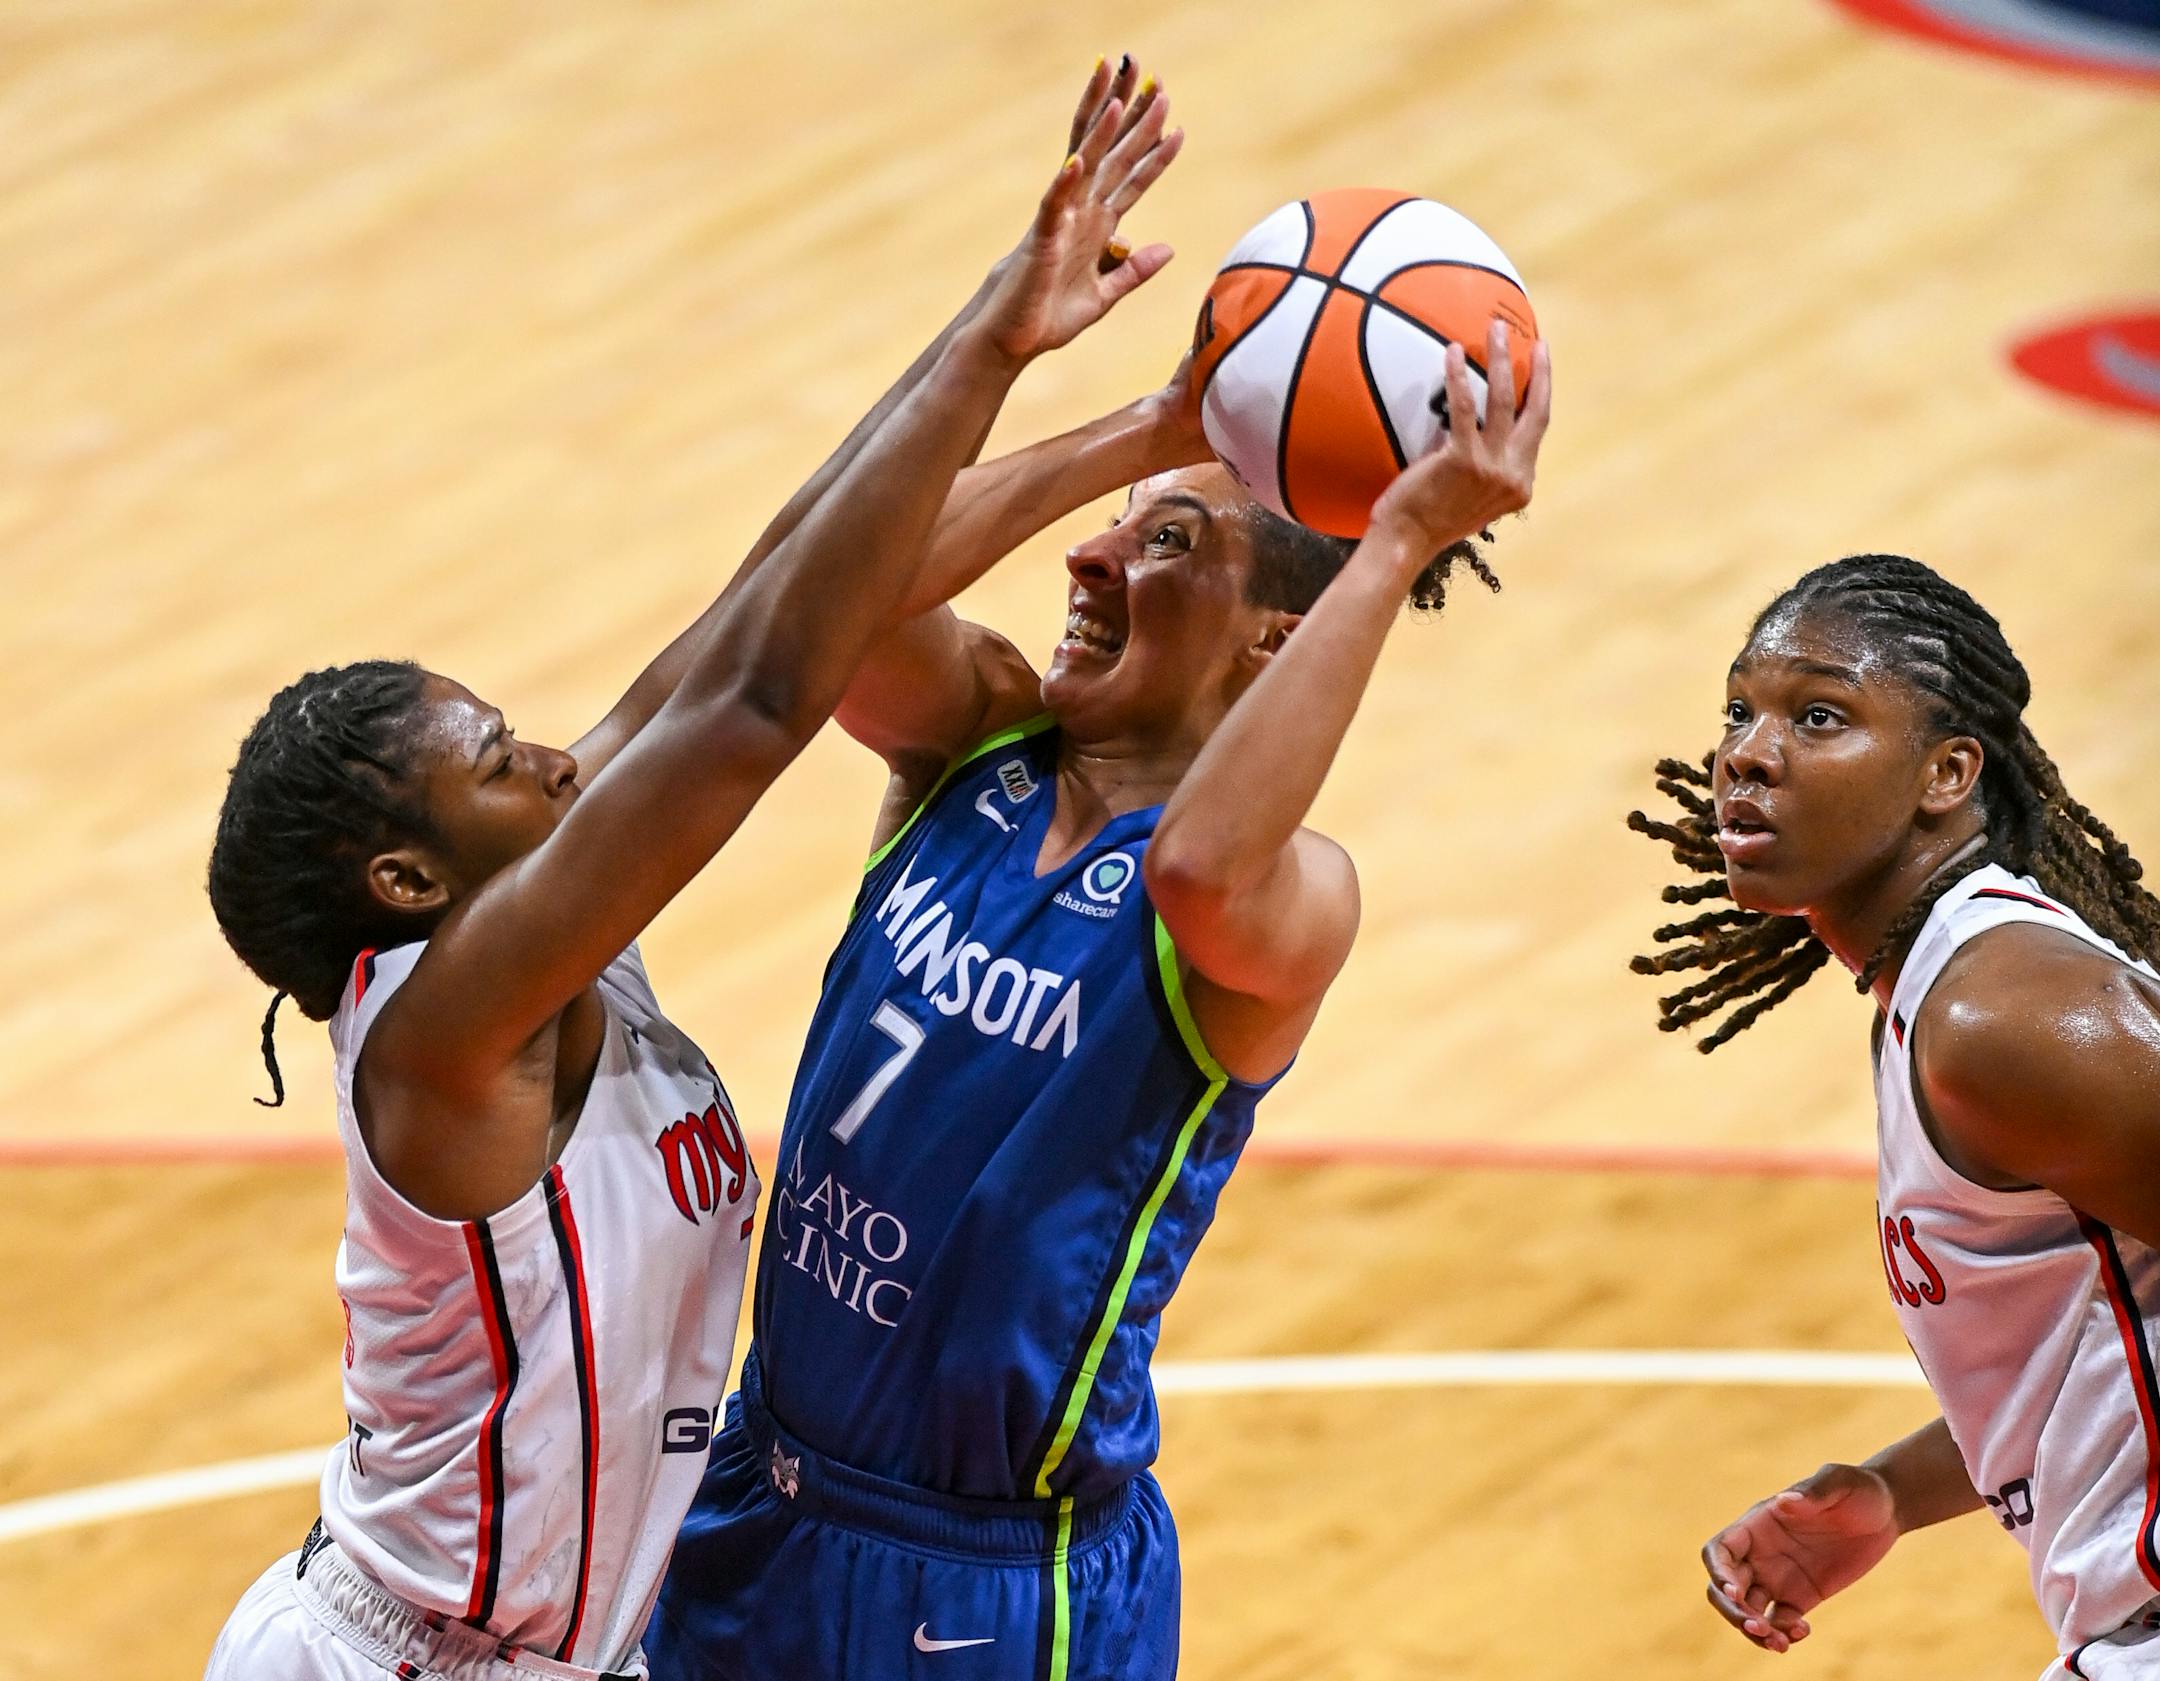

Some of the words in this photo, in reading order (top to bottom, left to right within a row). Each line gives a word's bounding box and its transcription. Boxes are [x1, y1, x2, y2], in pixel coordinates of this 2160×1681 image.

[875, 853, 1081, 1059] MINSOTA
[1052, 891, 1119, 918] sharecar
[829, 998, 926, 1145] 7
[777, 1187, 913, 1328] CINIC
